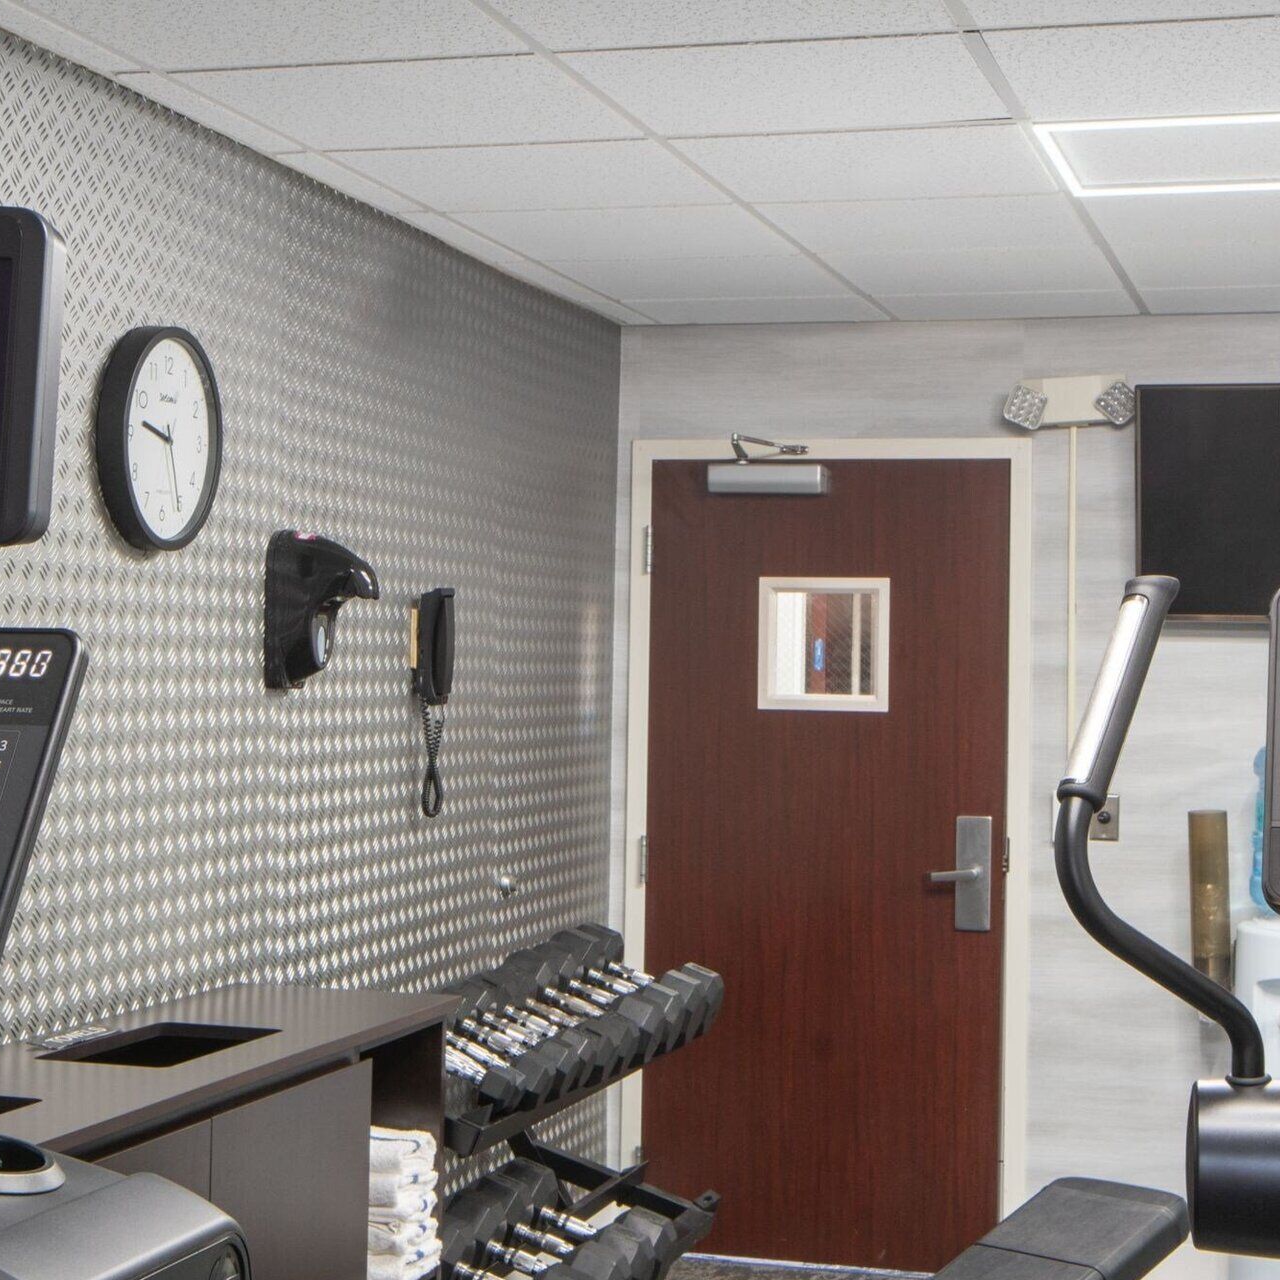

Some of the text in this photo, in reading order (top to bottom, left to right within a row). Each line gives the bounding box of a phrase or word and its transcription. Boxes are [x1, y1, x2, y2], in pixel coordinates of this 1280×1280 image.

[149, 362, 158, 381] 11
[164, 355, 174, 375] 12
[183, 369, 188, 389] 1
[135, 389, 148, 410] 10
[192, 400, 199, 419] 2
[128, 424, 134, 441] 9
[195, 435, 202, 454] 3
[131, 462, 138, 482] 8
[189, 471, 196, 487] 4
[143, 491, 150, 510] 7
[158, 505, 166, 522] 6
